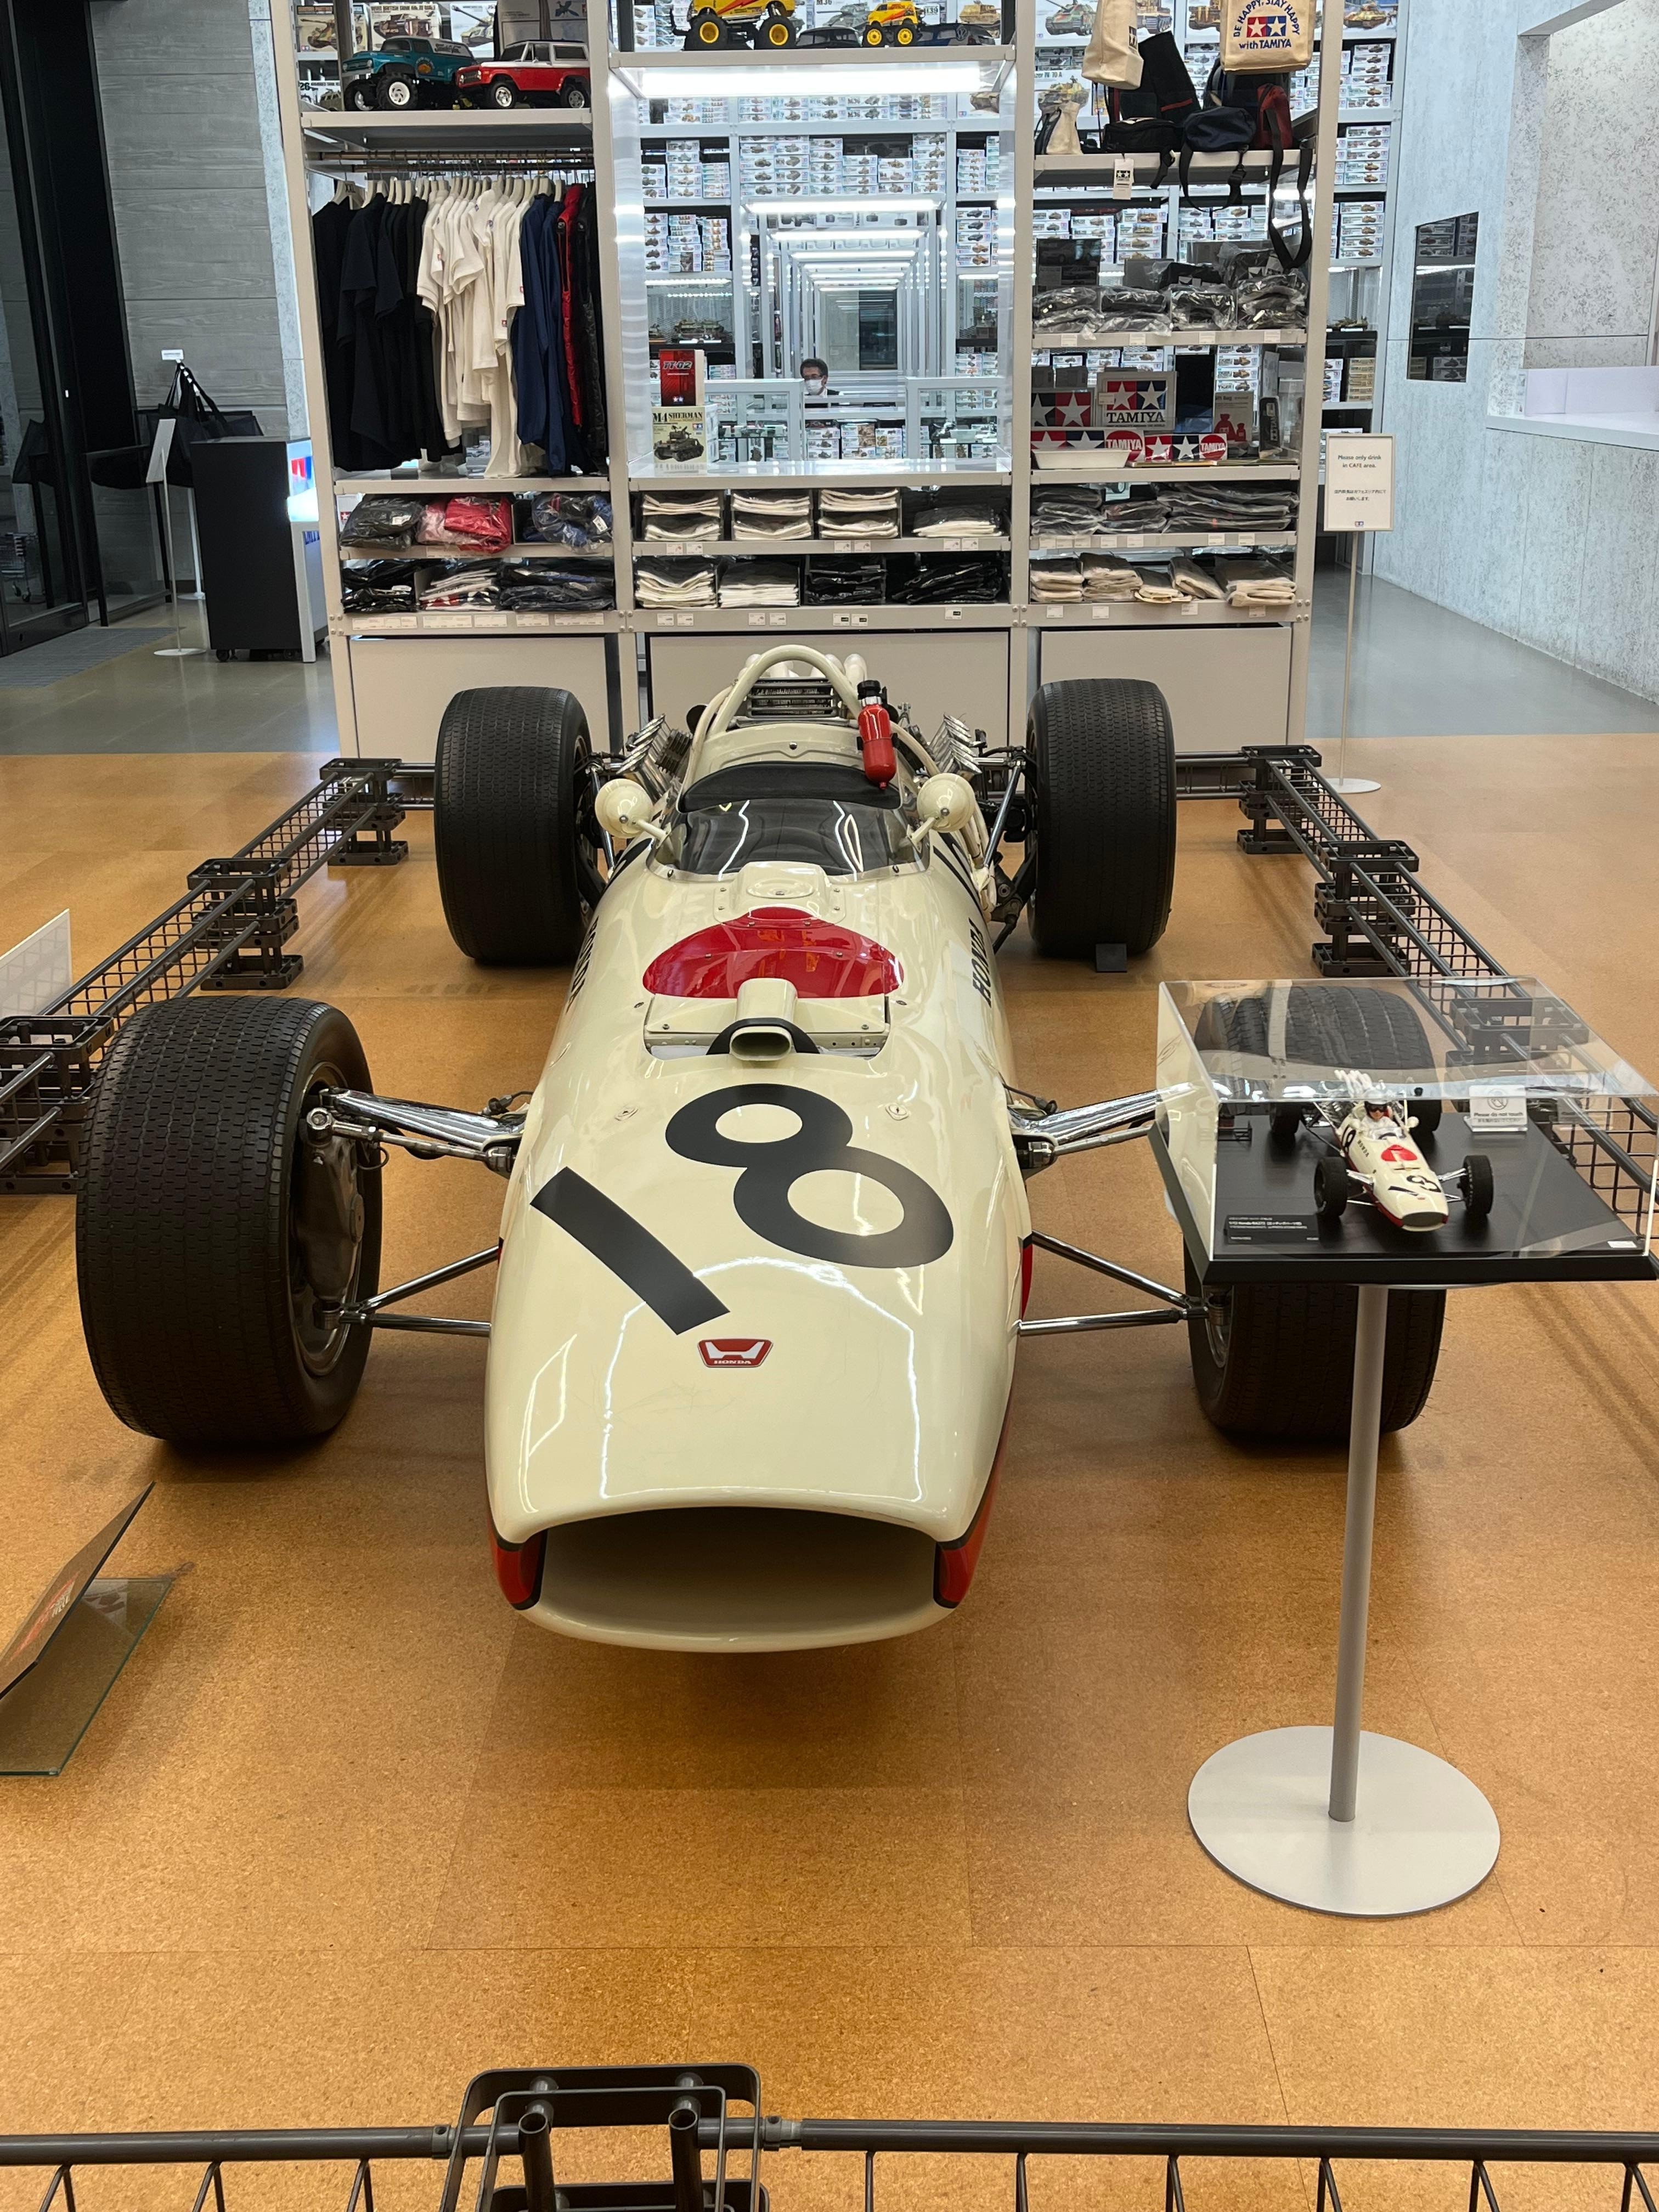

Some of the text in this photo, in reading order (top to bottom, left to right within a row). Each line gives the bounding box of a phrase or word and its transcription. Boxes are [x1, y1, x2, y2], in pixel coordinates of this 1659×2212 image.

[1239, 38, 1291, 49] with TAMIYA
[663, 360, 693, 370] TT-02
[653, 413, 668, 422] M4
[1106, 411, 1166, 424] TAMIYA
[1106, 439, 1142, 450] TAMIYA
[1200, 442, 1226, 452] TAMIYA
[968, 917, 992, 1008] HONDA
[1357, 1139, 1370, 1158] HONDA
[529, 1083, 954, 1335] 18
